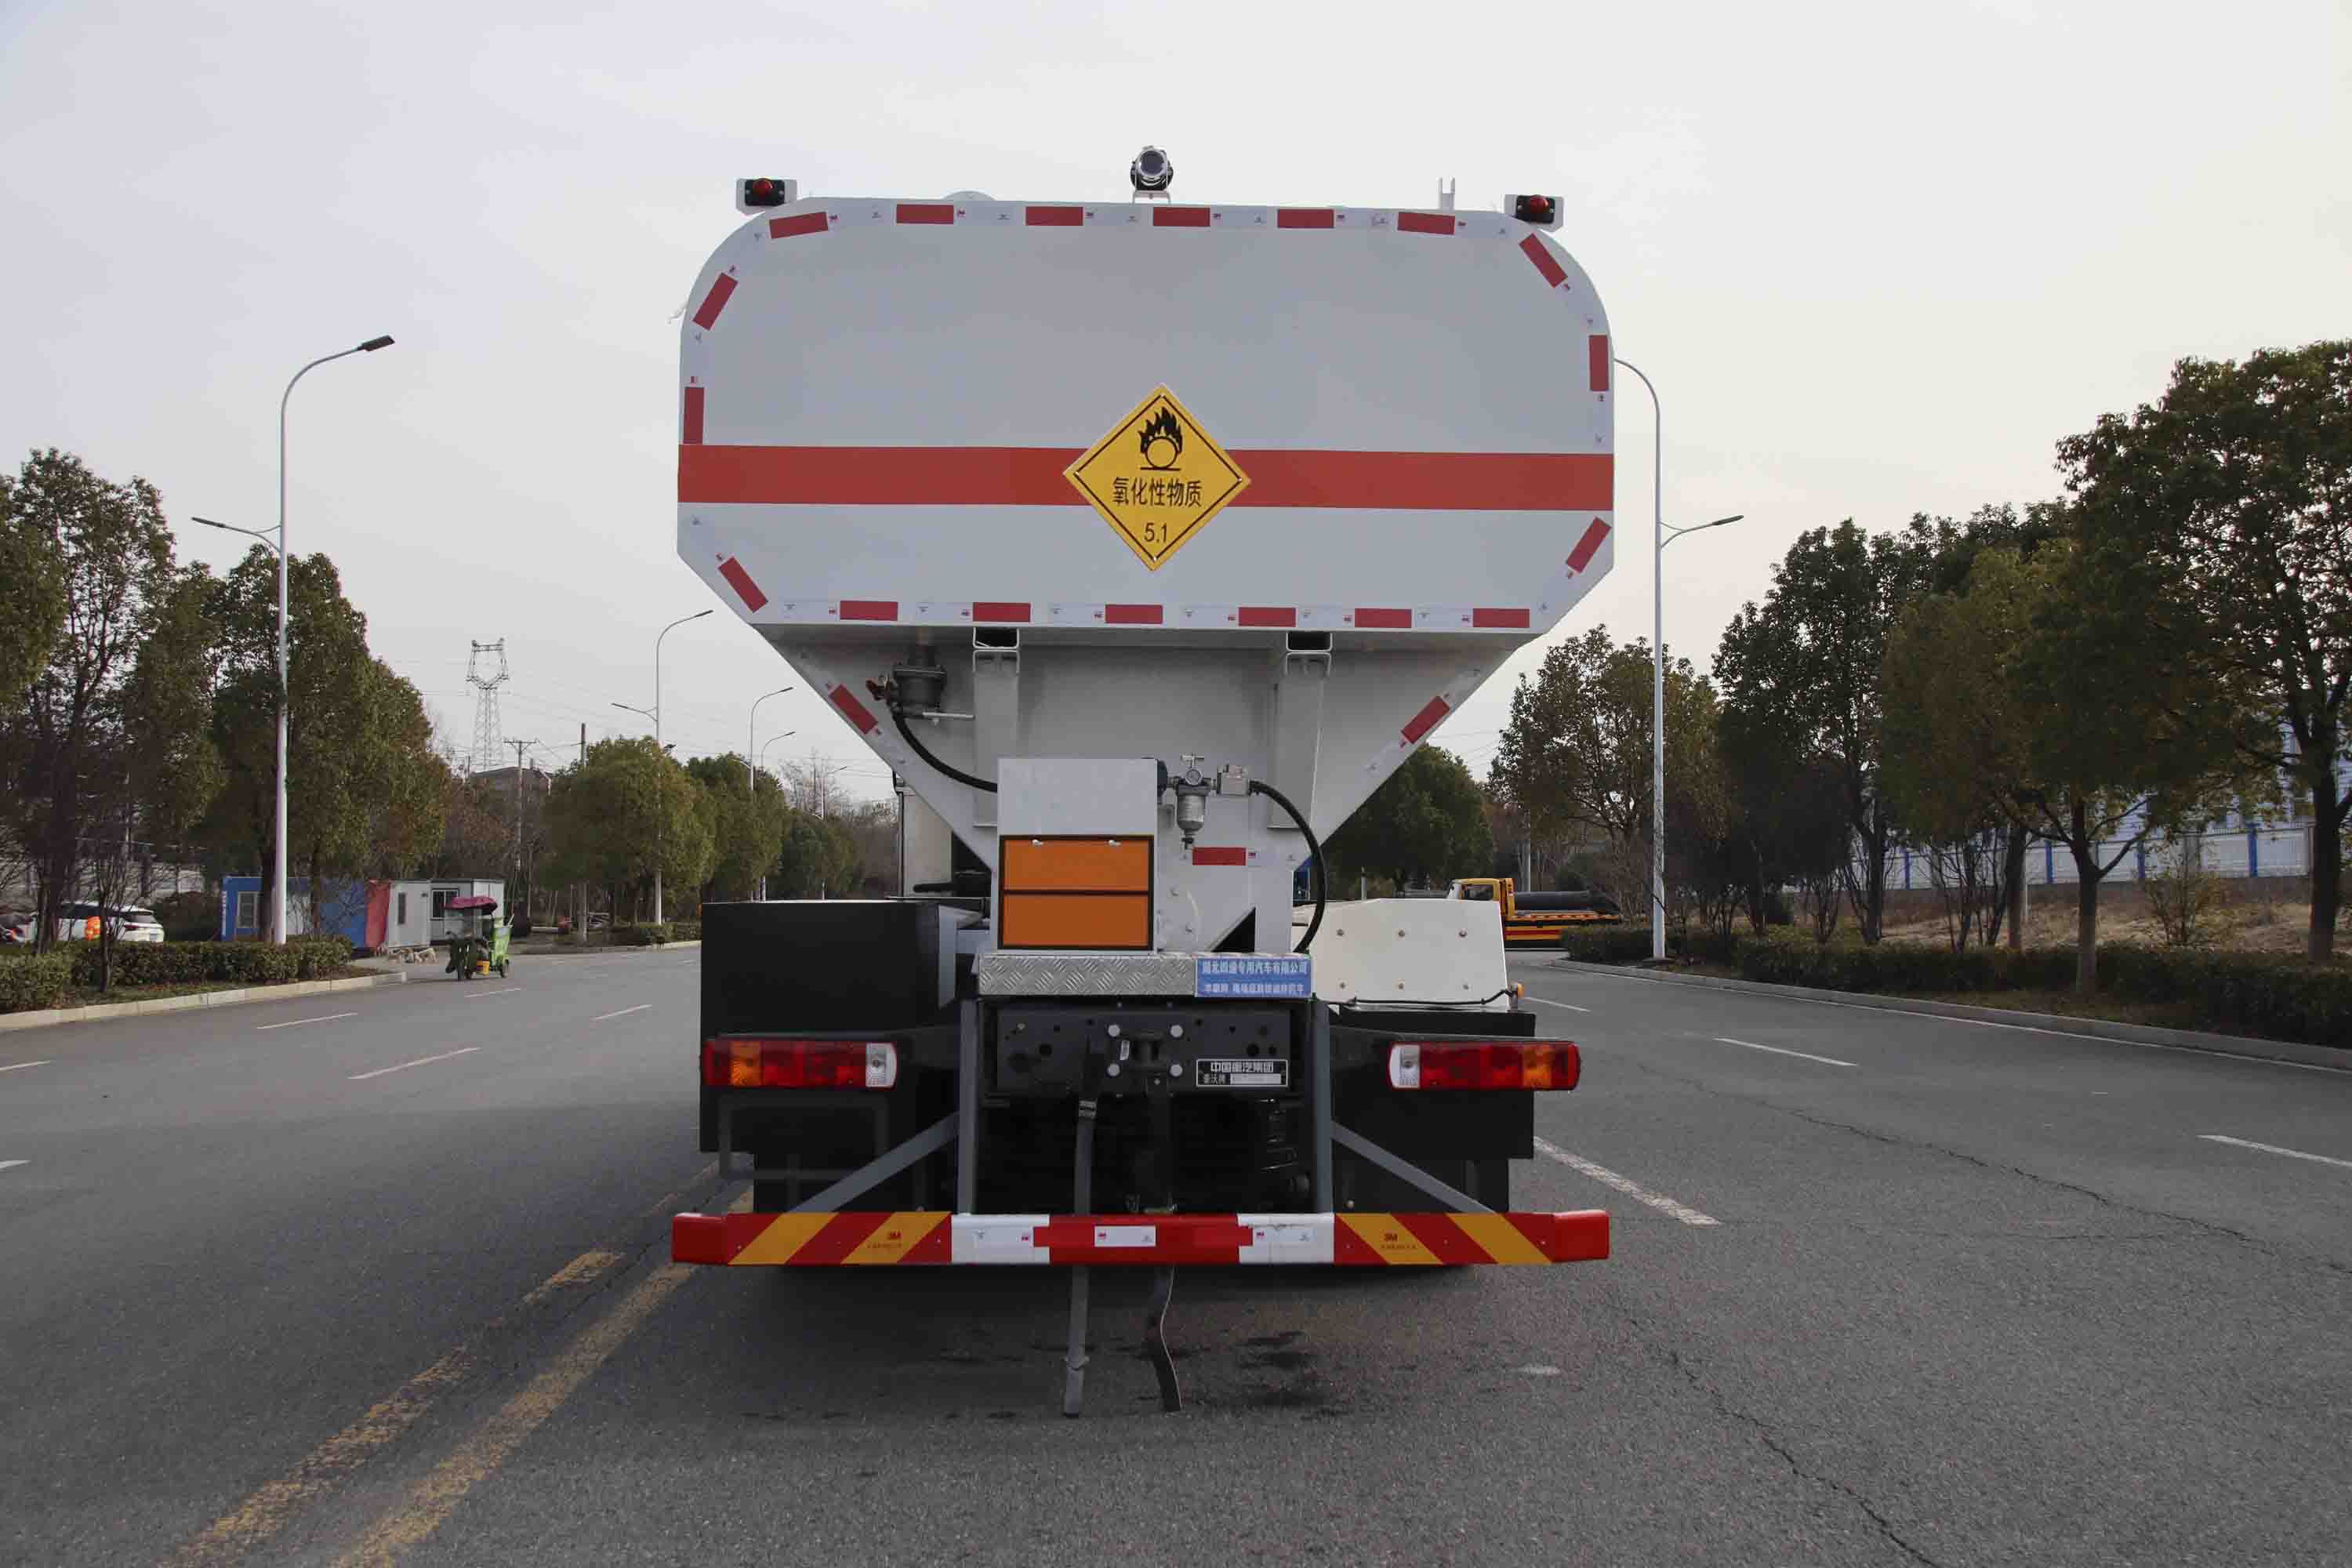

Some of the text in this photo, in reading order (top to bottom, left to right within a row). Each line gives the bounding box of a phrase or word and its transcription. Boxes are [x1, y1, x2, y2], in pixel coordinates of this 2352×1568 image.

[1112, 476, 1202, 508] 氧化性物质
[1143, 522, 1168, 543] 5.1
